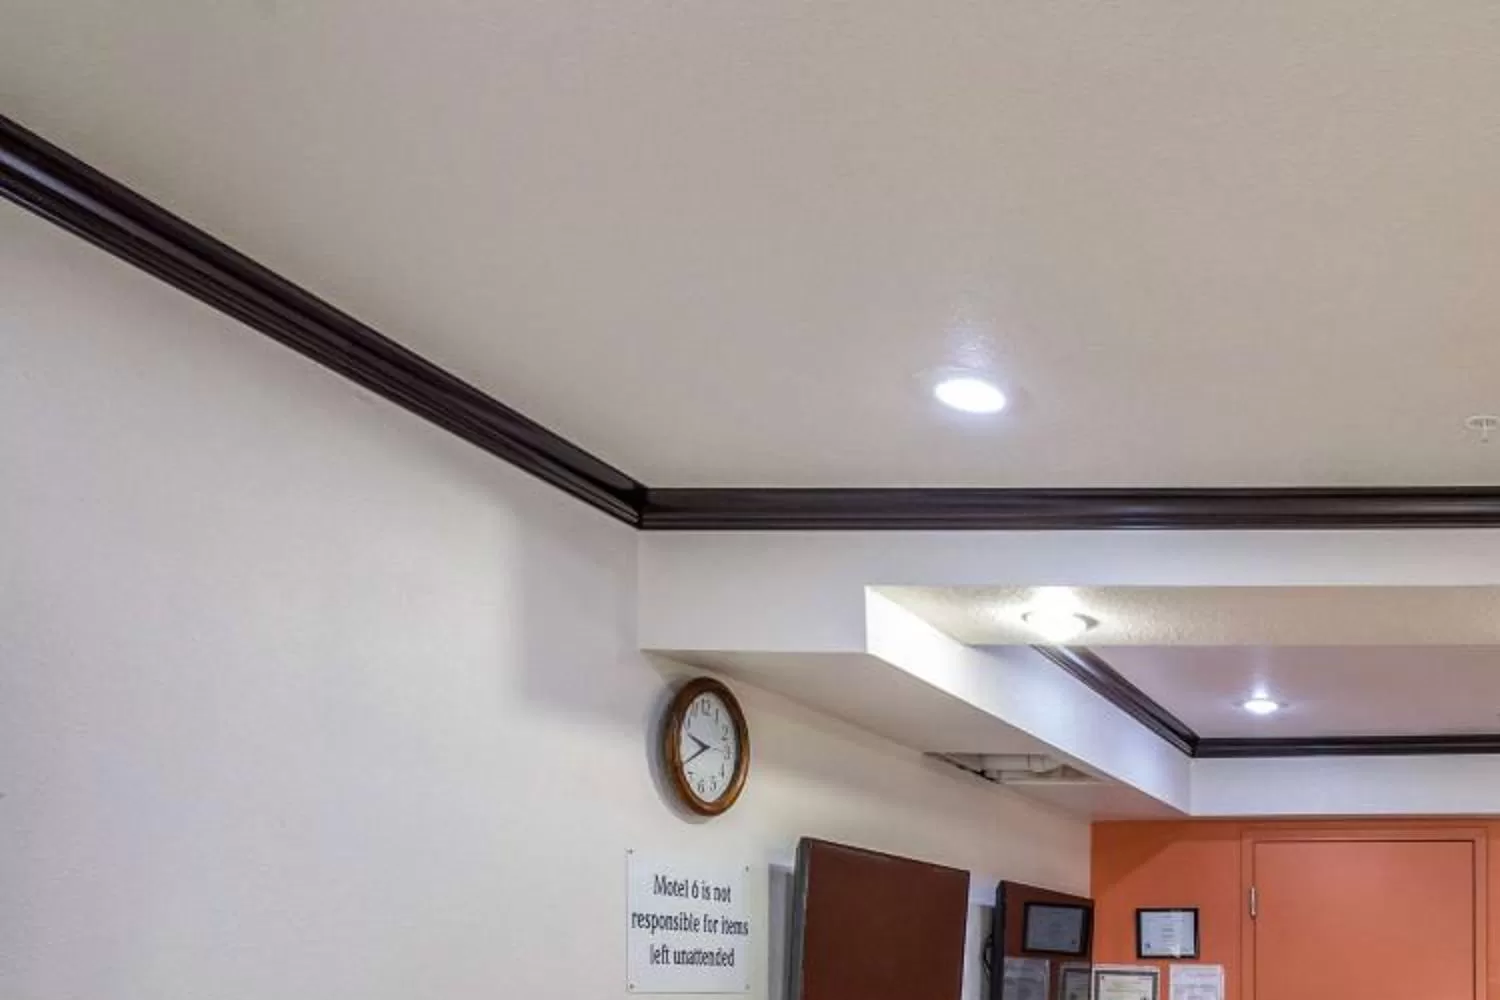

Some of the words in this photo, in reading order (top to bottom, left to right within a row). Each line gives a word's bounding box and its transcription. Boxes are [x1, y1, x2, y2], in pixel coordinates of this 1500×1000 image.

[653, 874, 689, 899] Motel
[691, 880, 699, 899] 6
[702, 880, 711, 901] is
[713, 885, 732, 903] not
[631, 912, 701, 935] responsible
[703, 914, 719, 933] for
[721, 915, 749, 935] items
[649, 944, 671, 965] left
[673, 948, 735, 967] unattended
